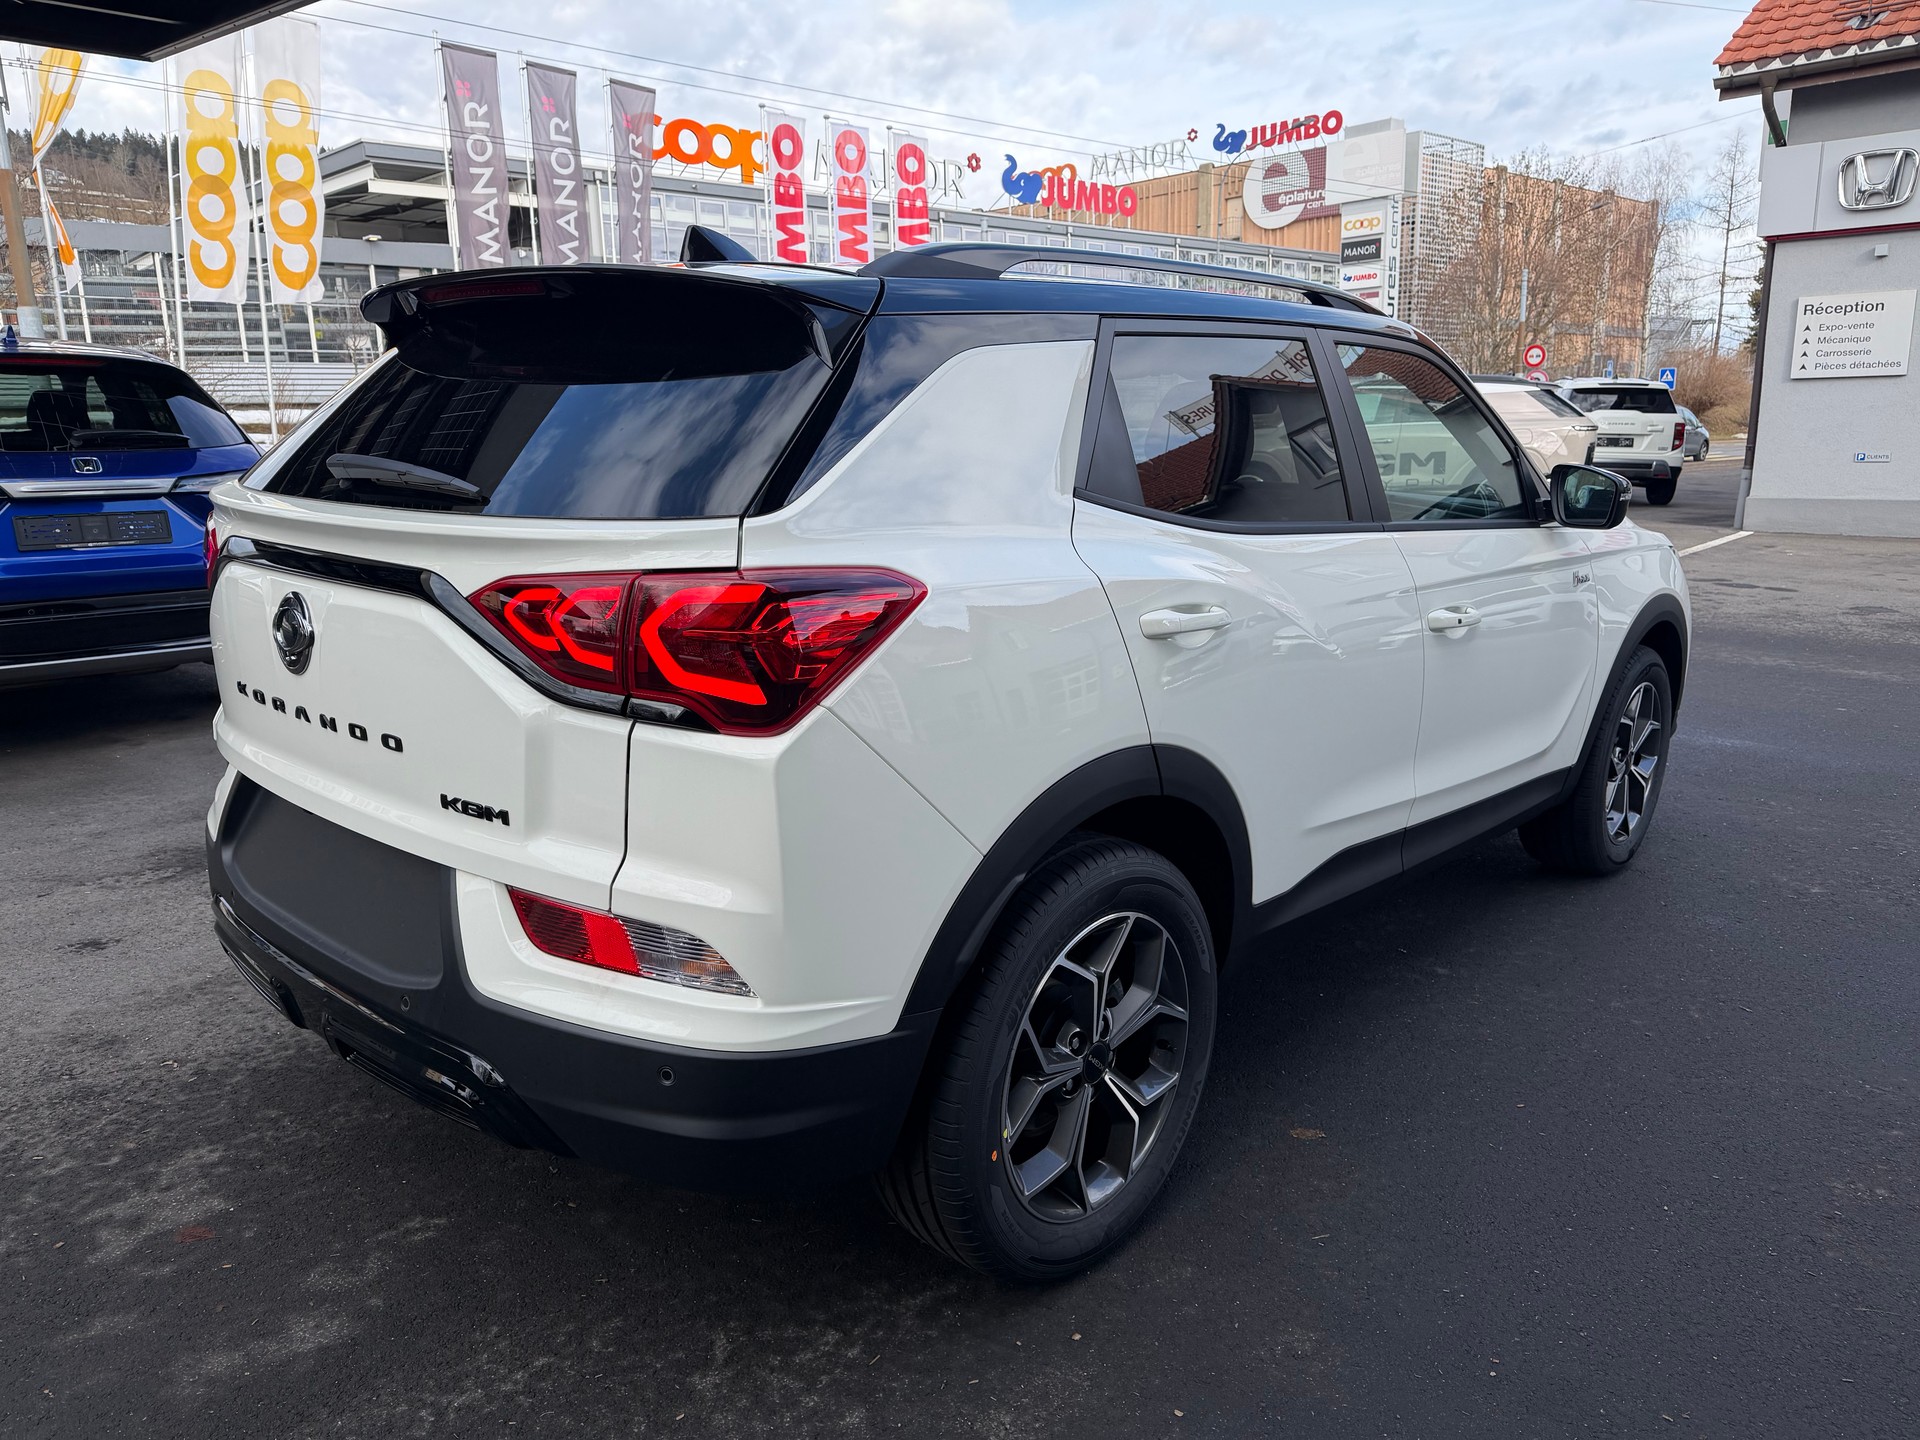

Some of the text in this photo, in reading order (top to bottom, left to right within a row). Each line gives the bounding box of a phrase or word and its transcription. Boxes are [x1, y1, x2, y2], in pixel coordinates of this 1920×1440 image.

[1246, 110, 1343, 150] JUMBO
[184, 69, 238, 289] coop
[263, 79, 319, 290] coop
[463, 101, 504, 264] MANOR
[1041, 175, 1138, 217] JUMBO
[1344, 216, 1381, 231] coop
[1344, 244, 1376, 257] MANOR
[1353, 272, 1377, 282] JUMBO
[1803, 300, 1885, 316] Réception
[1818, 321, 1875, 333] Expo-vente
[1817, 335, 1872, 345] Mécanique
[1815, 347, 1872, 358] Carrosserie
[1814, 359, 1902, 371] Pièces détachées
[236, 680, 404, 753] KORANDO
[439, 793, 510, 826] KGM
